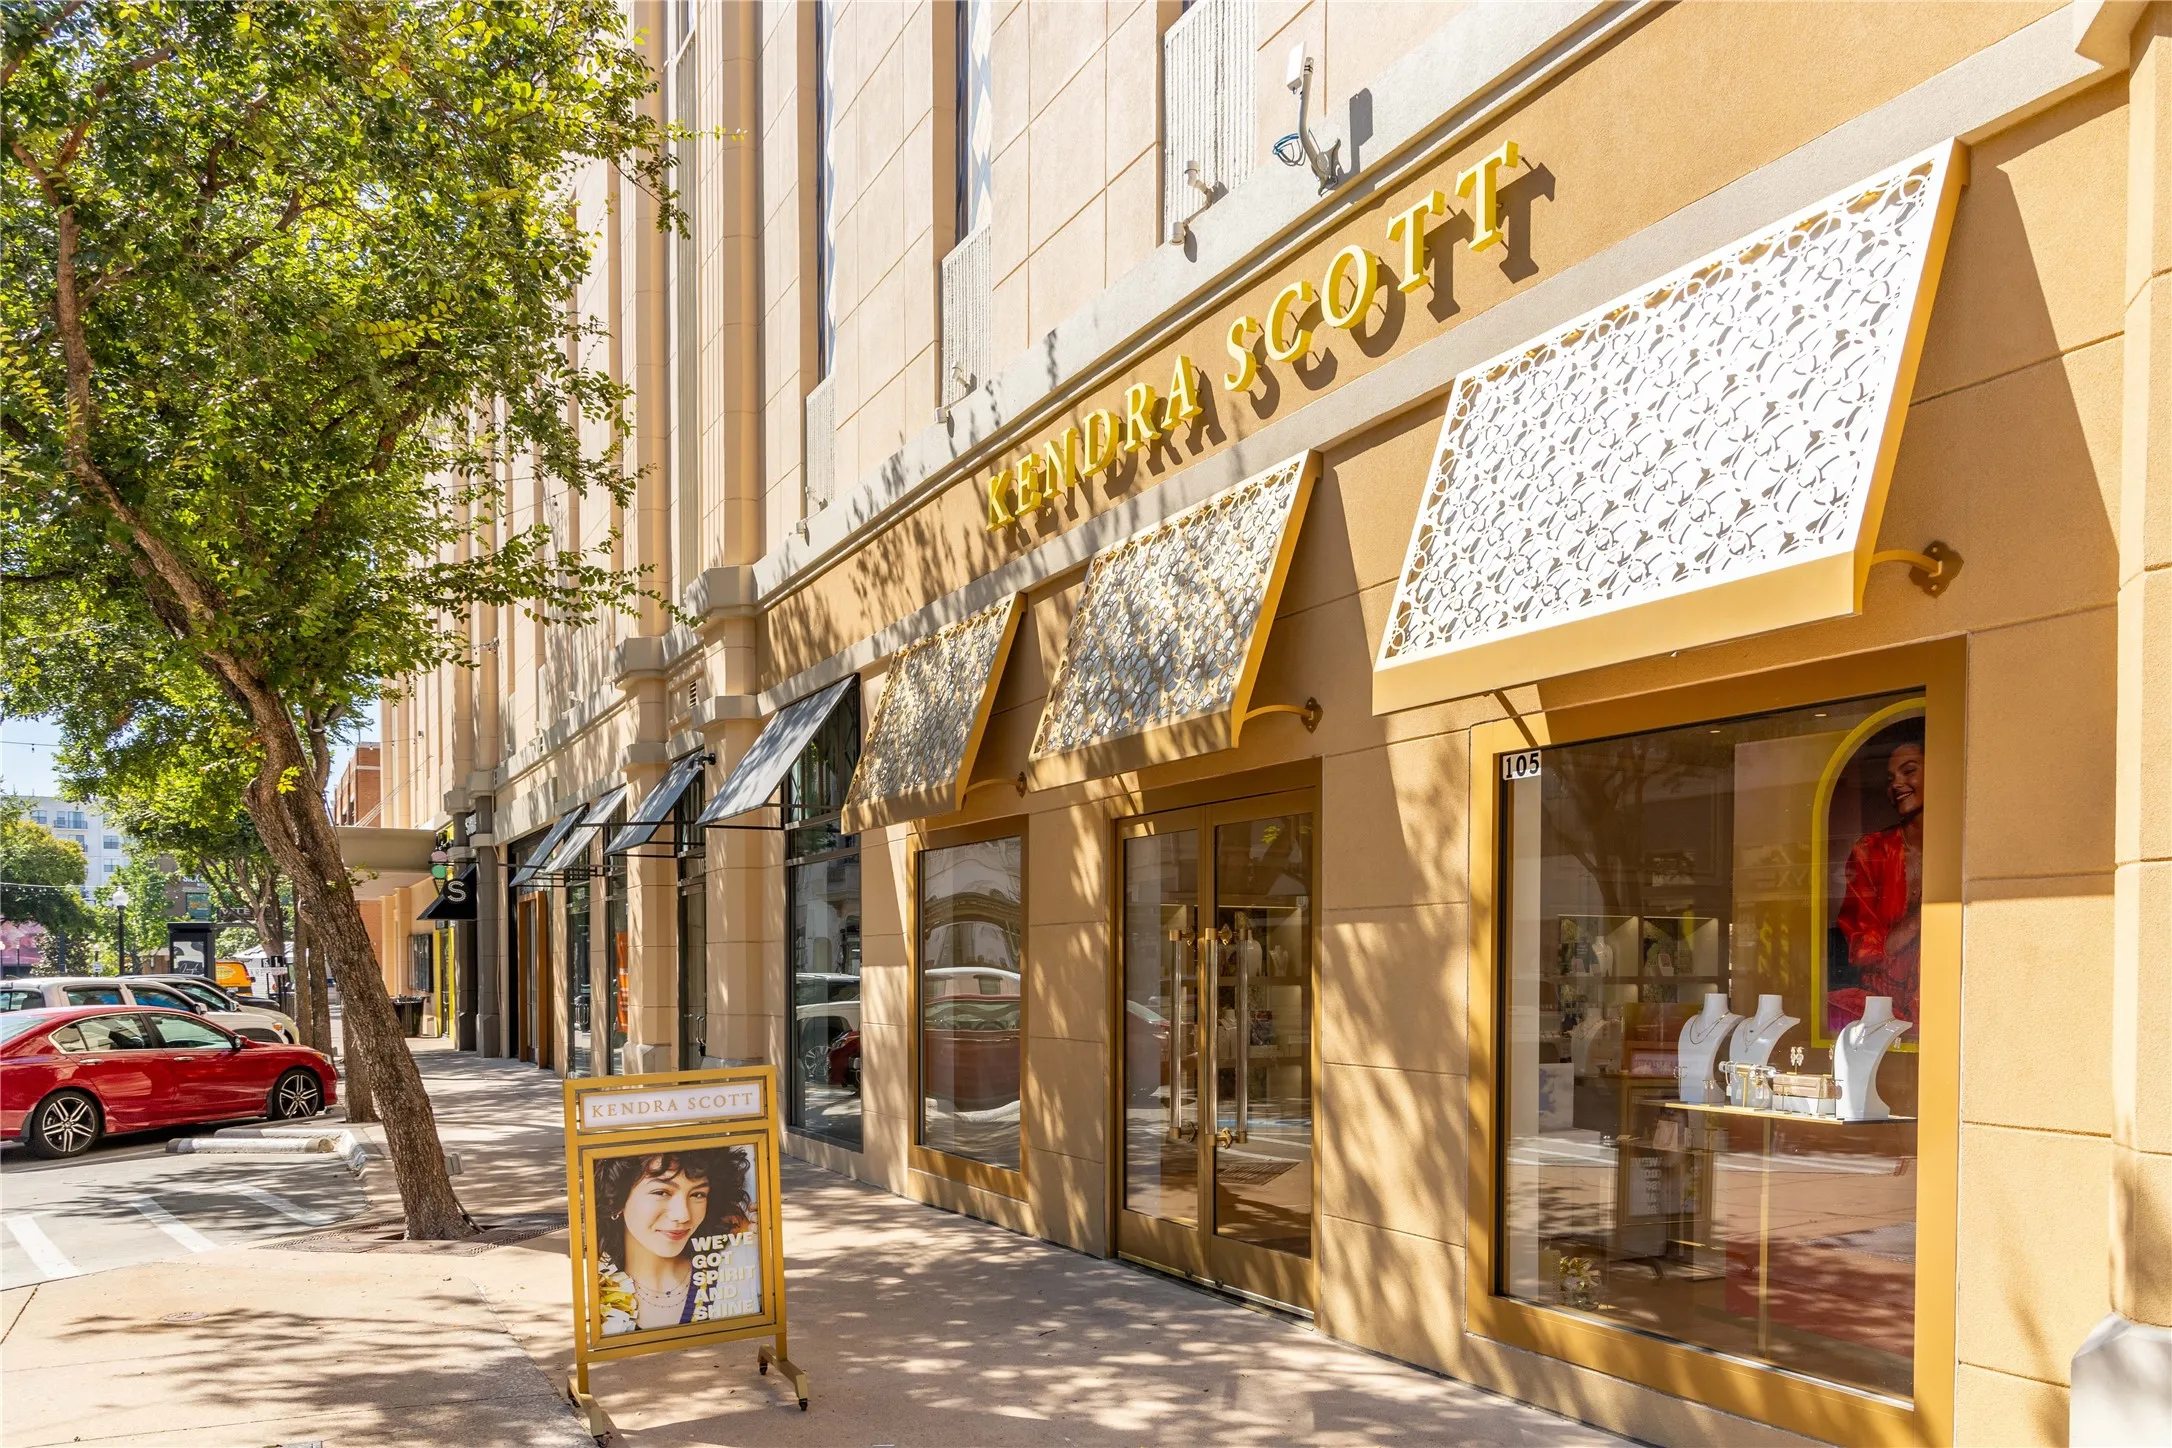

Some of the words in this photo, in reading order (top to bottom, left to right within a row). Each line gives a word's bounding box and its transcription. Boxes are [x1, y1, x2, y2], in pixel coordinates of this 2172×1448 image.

[985, 353, 1203, 532] KENDRA
[1223, 140, 1519, 392] SCOTT
[1506, 753, 1540, 779] 105
[447, 880, 467, 902] S
[592, 1099, 678, 1118] KENDRA
[688, 1092, 754, 1110] SCOTT
[691, 1231, 754, 1252] WE'VE
[692, 1250, 733, 1269] GOT
[692, 1264, 756, 1286] SPIRIT
[694, 1285, 738, 1304] AND
[695, 1299, 754, 1321] SHINE
